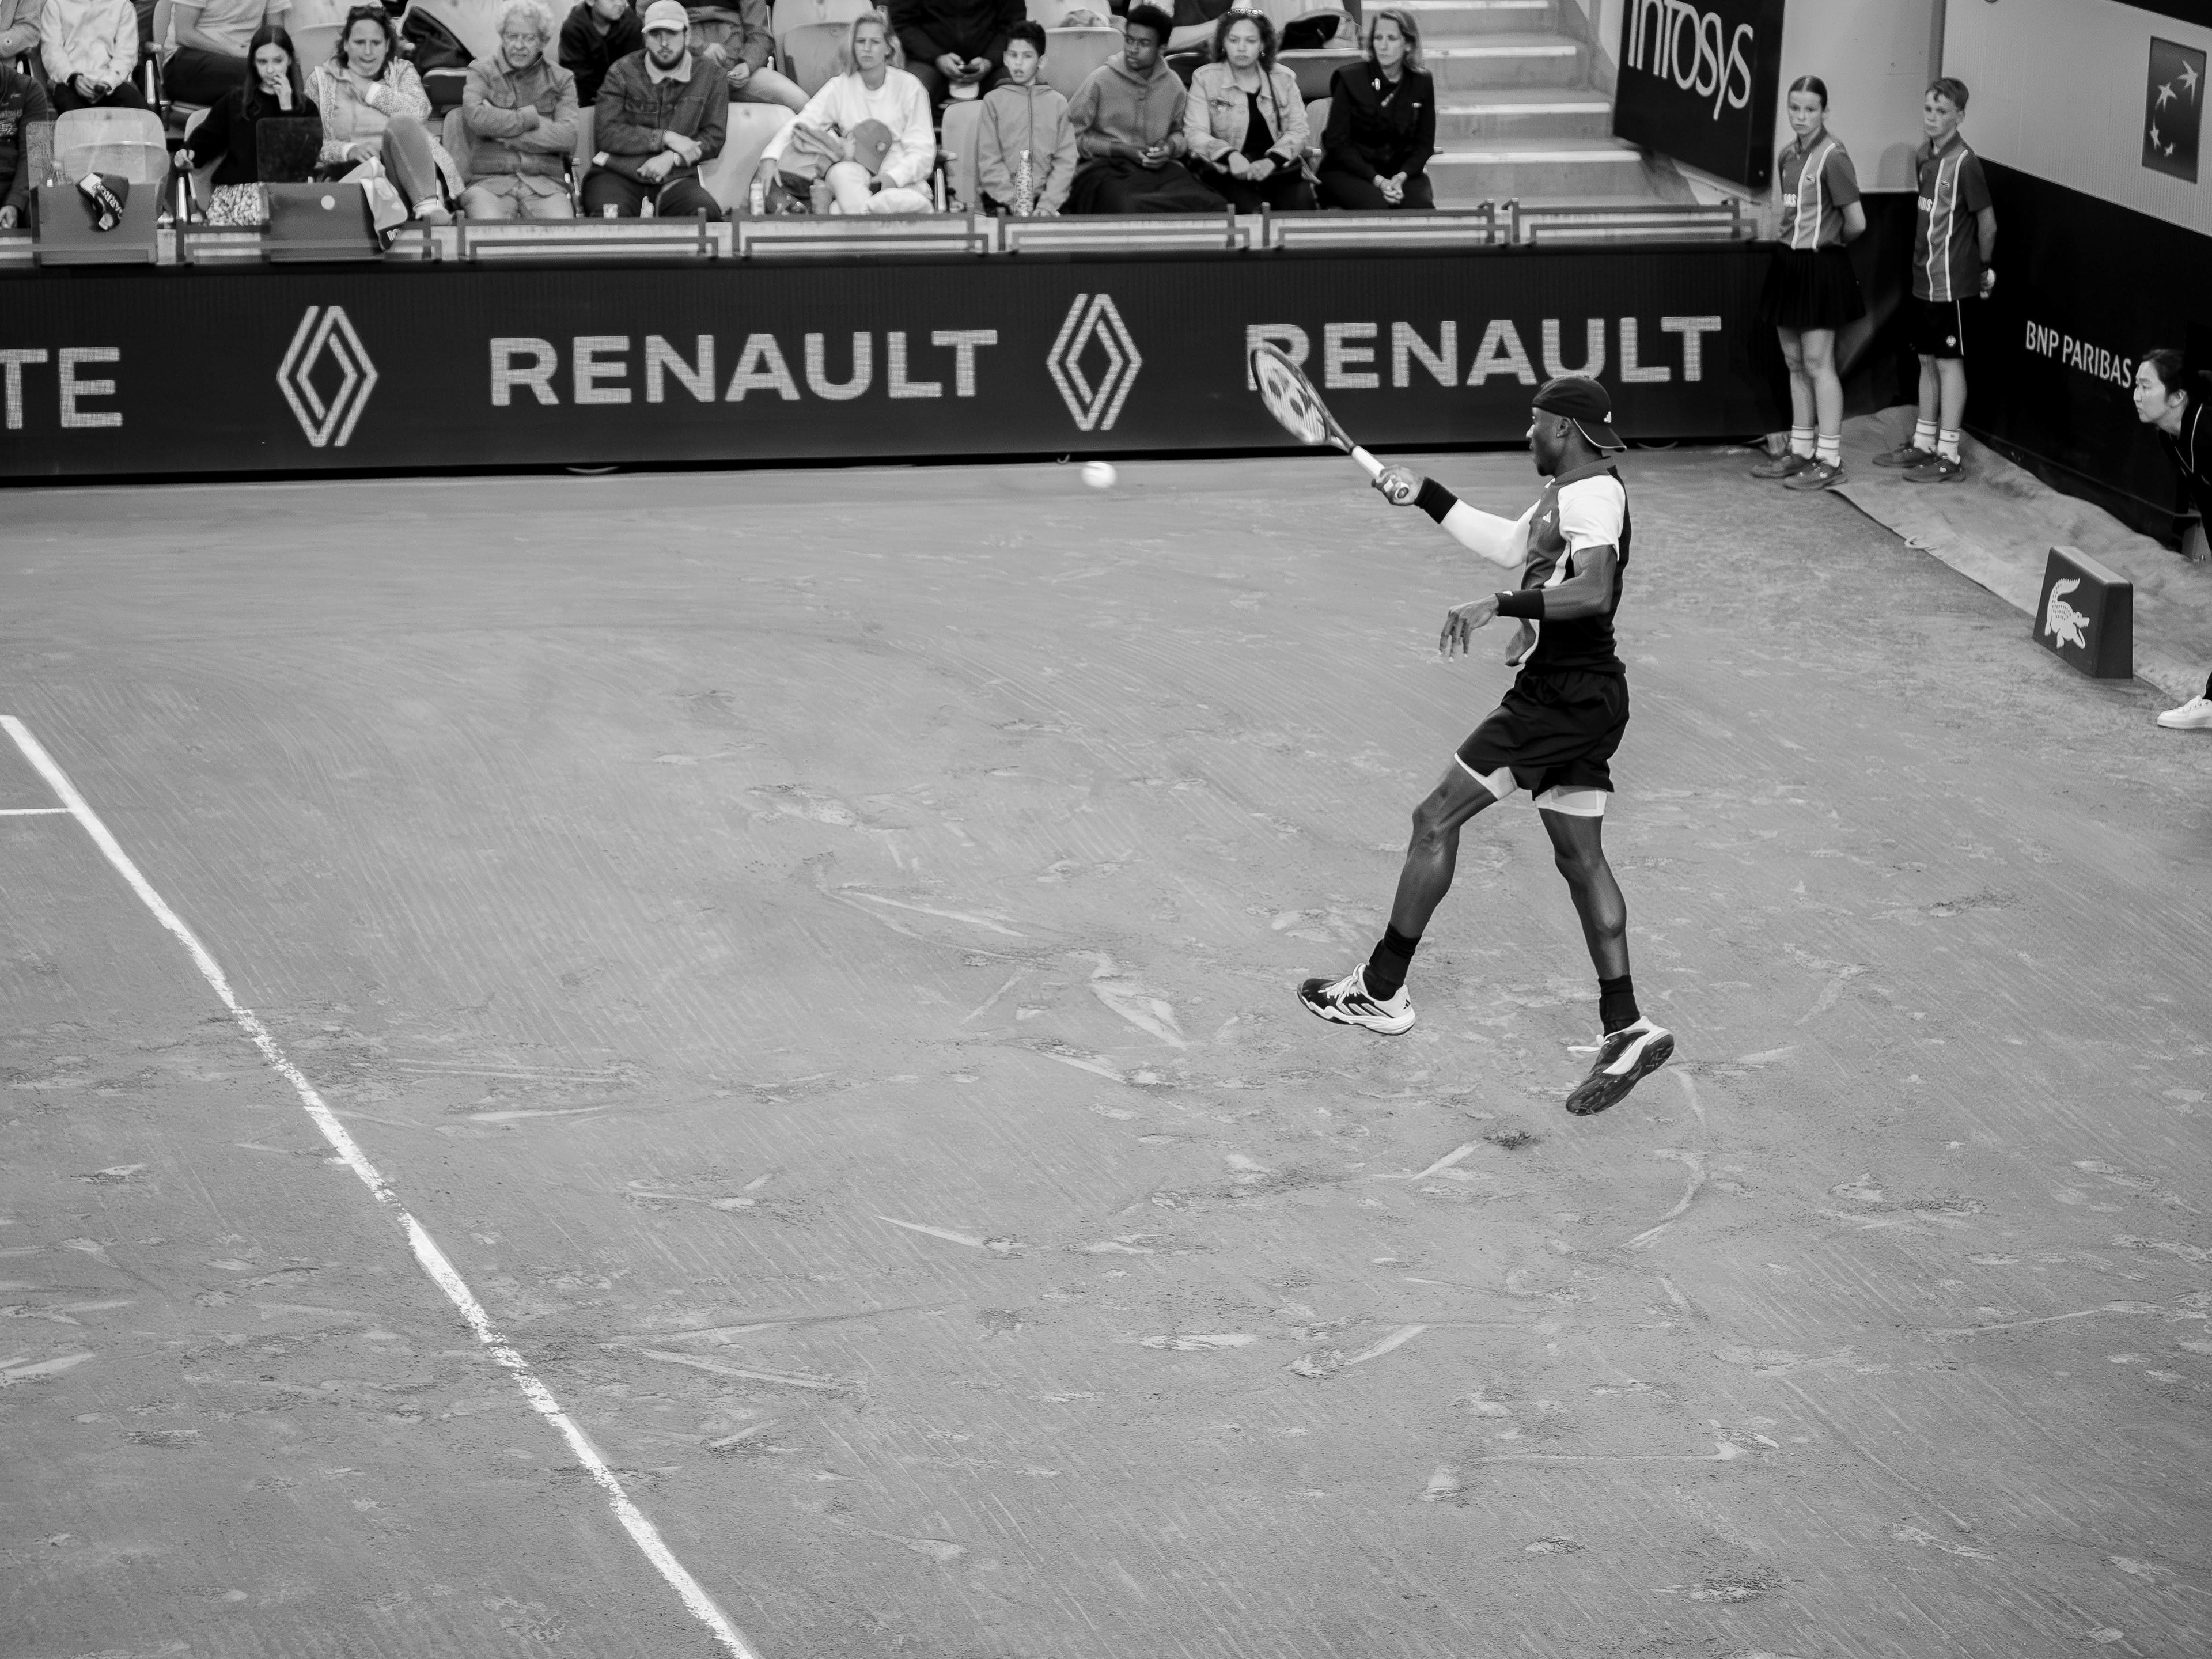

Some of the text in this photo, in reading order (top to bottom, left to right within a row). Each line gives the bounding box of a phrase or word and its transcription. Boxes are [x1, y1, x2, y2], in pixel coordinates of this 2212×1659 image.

[0, 347, 123, 430] TE
[490, 329, 998, 406] RENAULT
[2025, 320, 2131, 389] BNP PARIBAS
